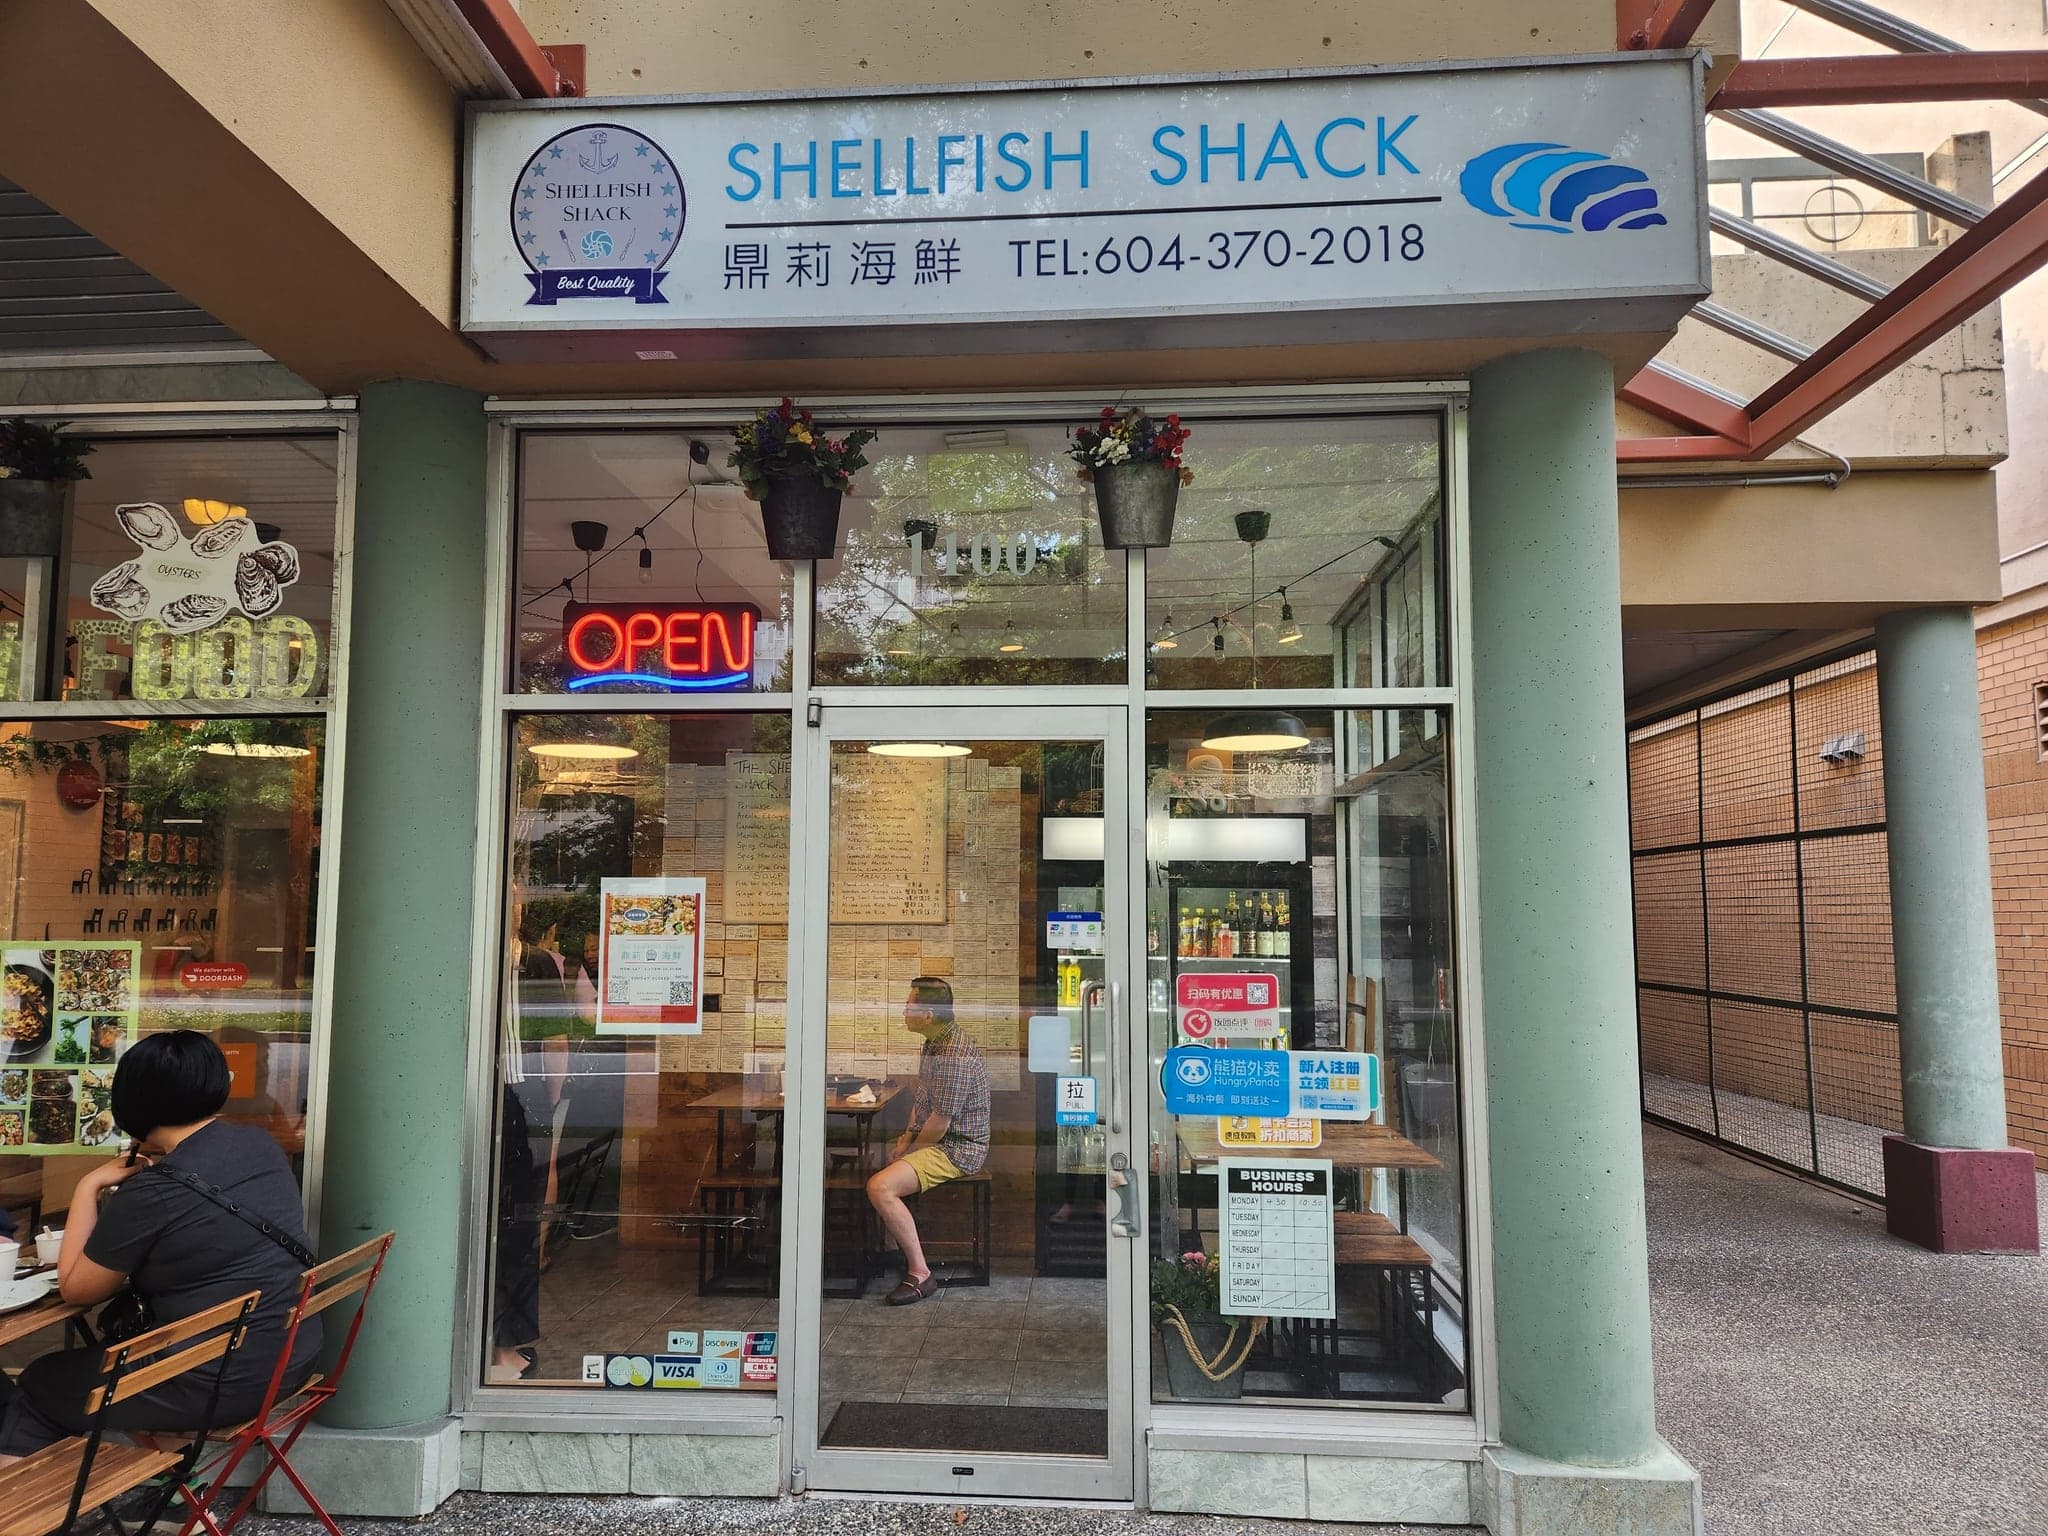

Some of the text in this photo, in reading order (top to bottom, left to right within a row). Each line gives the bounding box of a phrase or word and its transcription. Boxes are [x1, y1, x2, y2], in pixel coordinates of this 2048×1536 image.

[726, 113, 1421, 202] SHELLFISH SHACK
[545, 180, 651, 200] SHELLFISH
[562, 204, 632, 222] SHACK
[1008, 223, 1425, 278] TEL:604-370-2018
[723, 236, 961, 290] 鼎莉海鮮
[556, 273, 636, 296] Best Quality
[904, 530, 1038, 578] 1100
[157, 563, 201, 580] OYSTERS
[568, 610, 751, 674] OPEN
[67, 616, 318, 701] FOOD
[733, 759, 762, 774] THE
[1187, 988, 1244, 1000] 扫码有优惠
[1214, 1059, 1280, 1078] 熊猫外卖
[1299, 1059, 1360, 1075] 新人注册
[1214, 1076, 1280, 1088] HungryPanda
[1299, 1075, 1360, 1091] 立领红包
[1067, 1081, 1084, 1099] 拉
[1065, 1101, 1086, 1110] PULL
[1186, 1093, 1270, 1106] 海外中餐 即刻送达
[1240, 1170, 1315, 1182] BUSINESS
[1252, 1182, 1304, 1193] HOURS
[1231, 1197, 1258, 1205] MONDAY
[1231, 1212, 1260, 1221] TUESDAY
[1231, 1229, 1260, 1238] WEDNESDAY
[1231, 1245, 1260, 1254] THURSDAY
[1232, 1262, 1260, 1270] FRIDAY
[1232, 1278, 1260, 1287] SATURDAY
[1232, 1294, 1261, 1303] SUNDAY
[679, 1337, 694, 1347] Pay
[705, 1339, 738, 1348] DISCOVER
[662, 1365, 695, 1378] VISA
